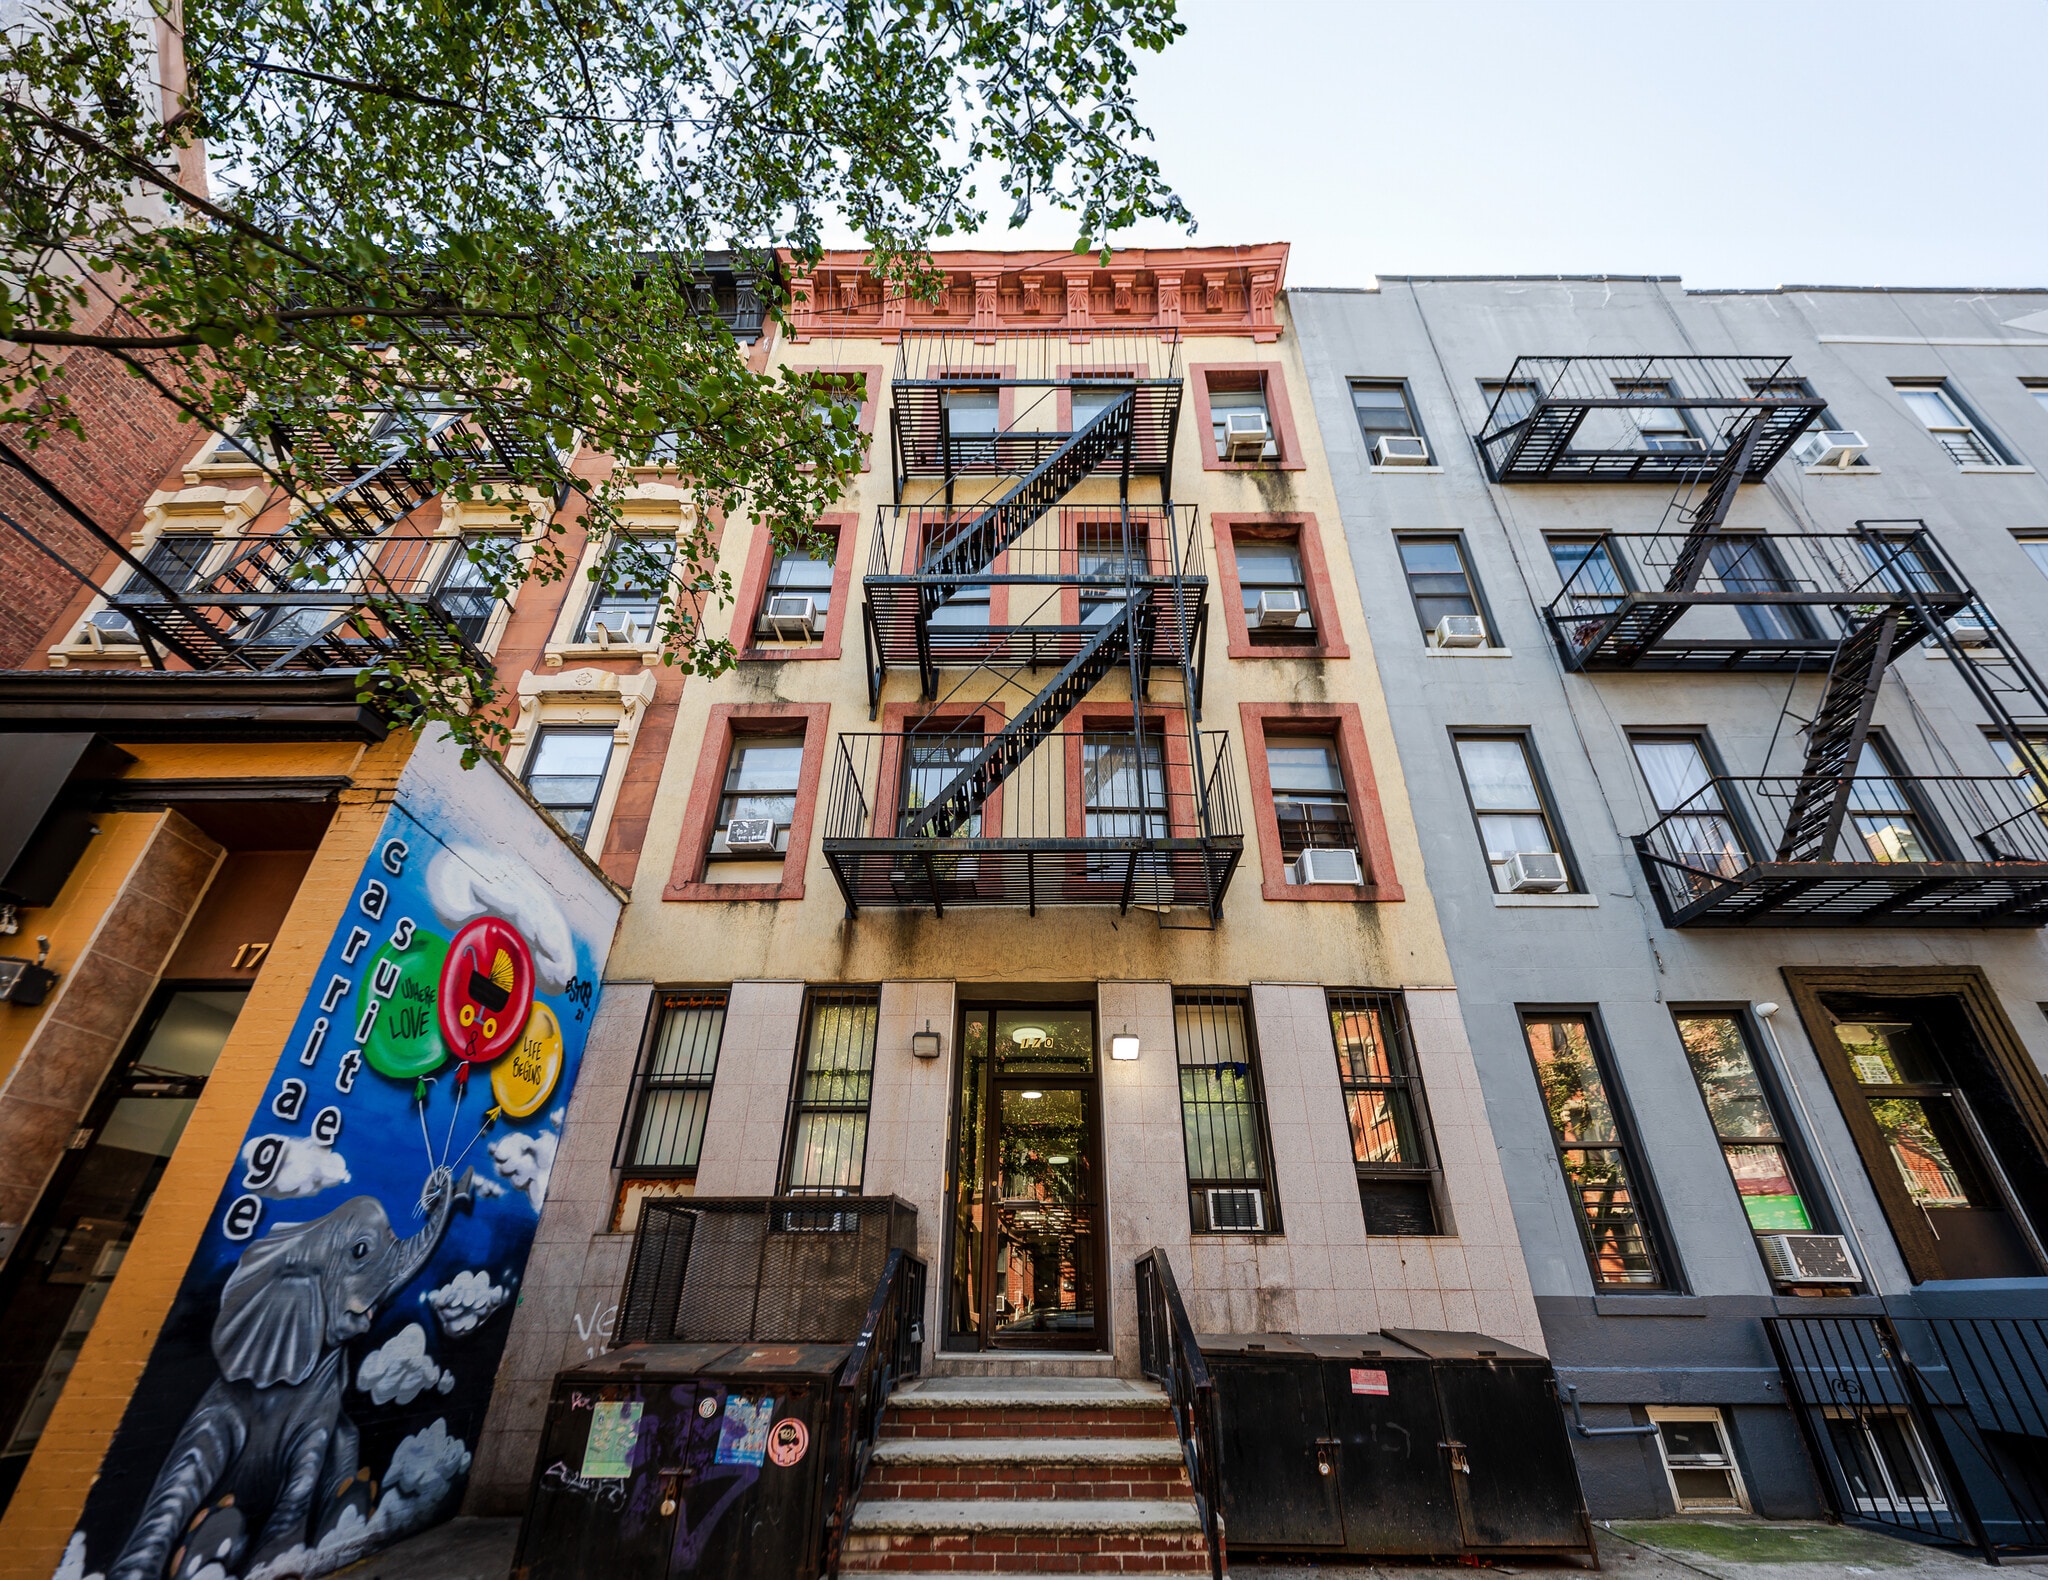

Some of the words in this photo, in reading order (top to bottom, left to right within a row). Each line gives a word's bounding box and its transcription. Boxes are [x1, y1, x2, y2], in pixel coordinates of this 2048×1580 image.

[401, 977, 437, 1008] WHERE
[389, 1006, 430, 1039] LOVE
[465, 1030, 478, 1057] &
[523, 1036, 542, 1061] LIFE
[1020, 1037, 1053, 1048] 170
[512, 1056, 541, 1085] BEGINS
